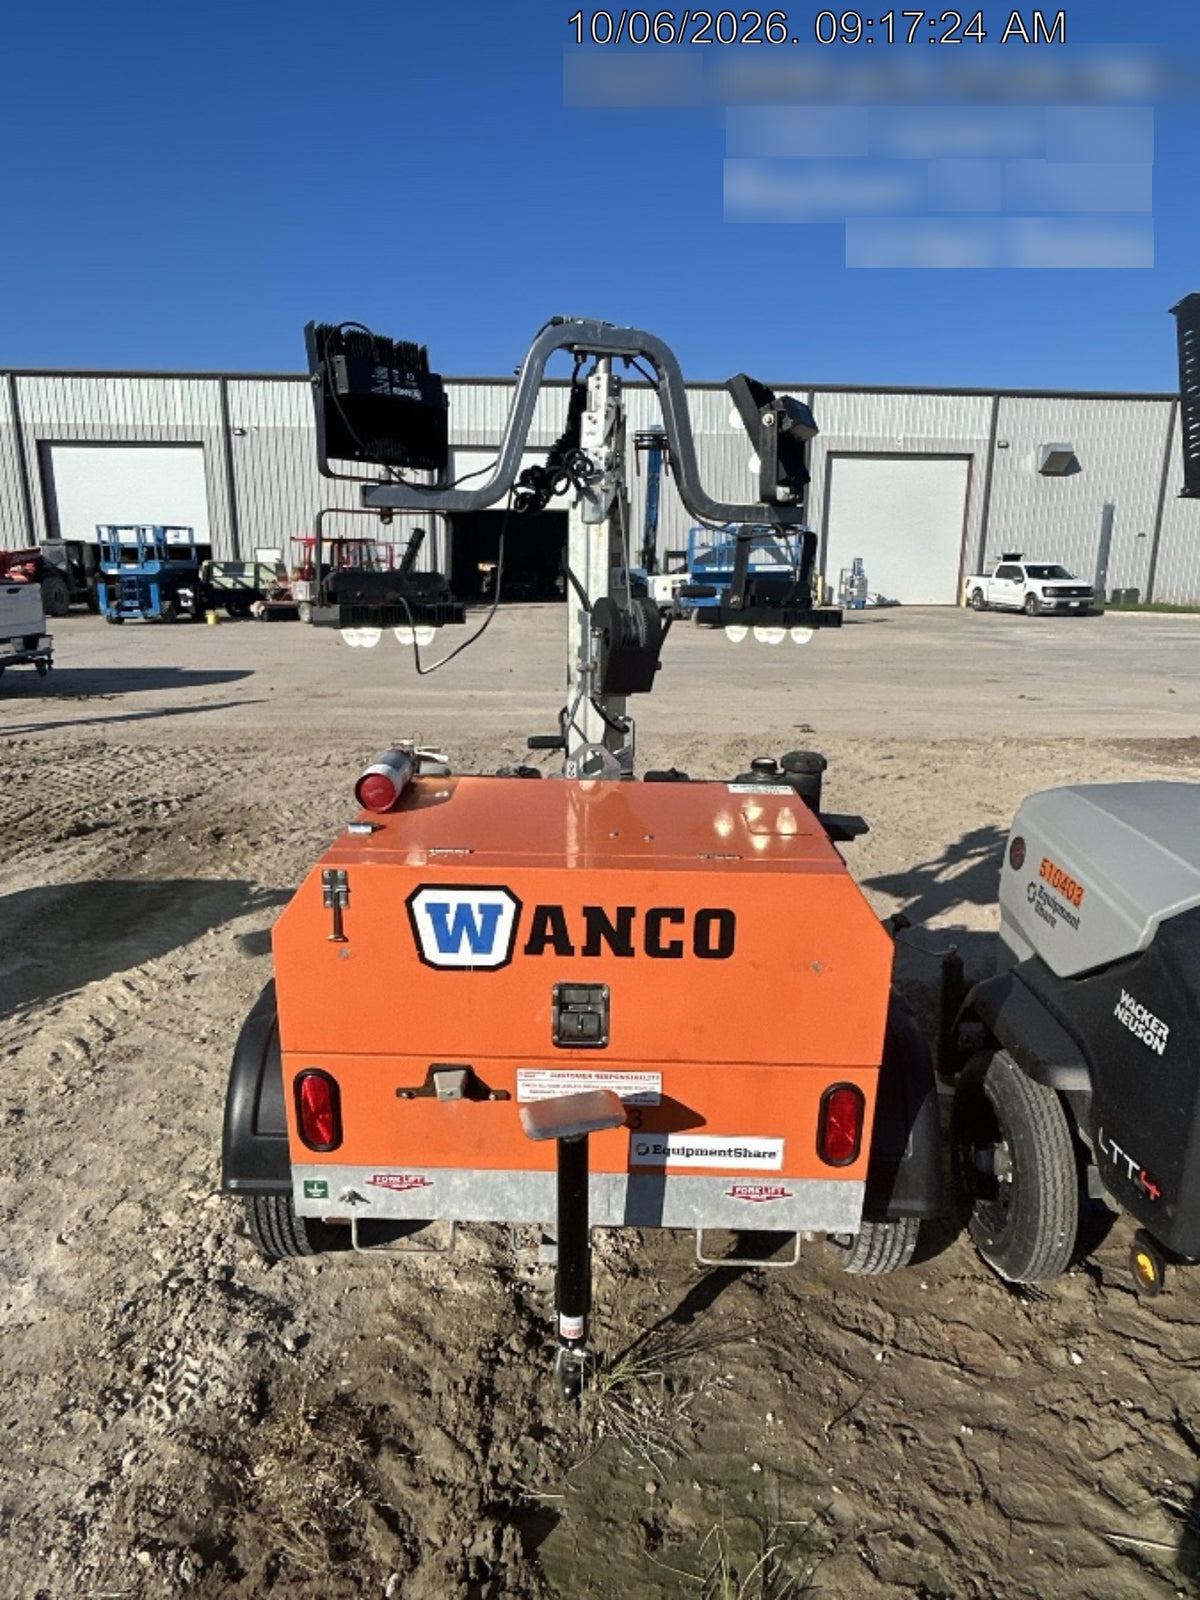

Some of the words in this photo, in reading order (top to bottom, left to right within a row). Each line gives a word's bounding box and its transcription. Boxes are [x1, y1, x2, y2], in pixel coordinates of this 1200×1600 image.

[1038, 885, 1080, 930] Equipment
[1039, 857, 1085, 909] 510403
[424, 902, 736, 958] WANCO
[1114, 1003, 1166, 1055] NEUSON
[1120, 988, 1170, 1042] WACKER
[549, 1071, 592, 1080] CUSTOMER
[652, 1144, 777, 1159] EquipmentShare
[1098, 1127, 1160, 1200] LTT4
